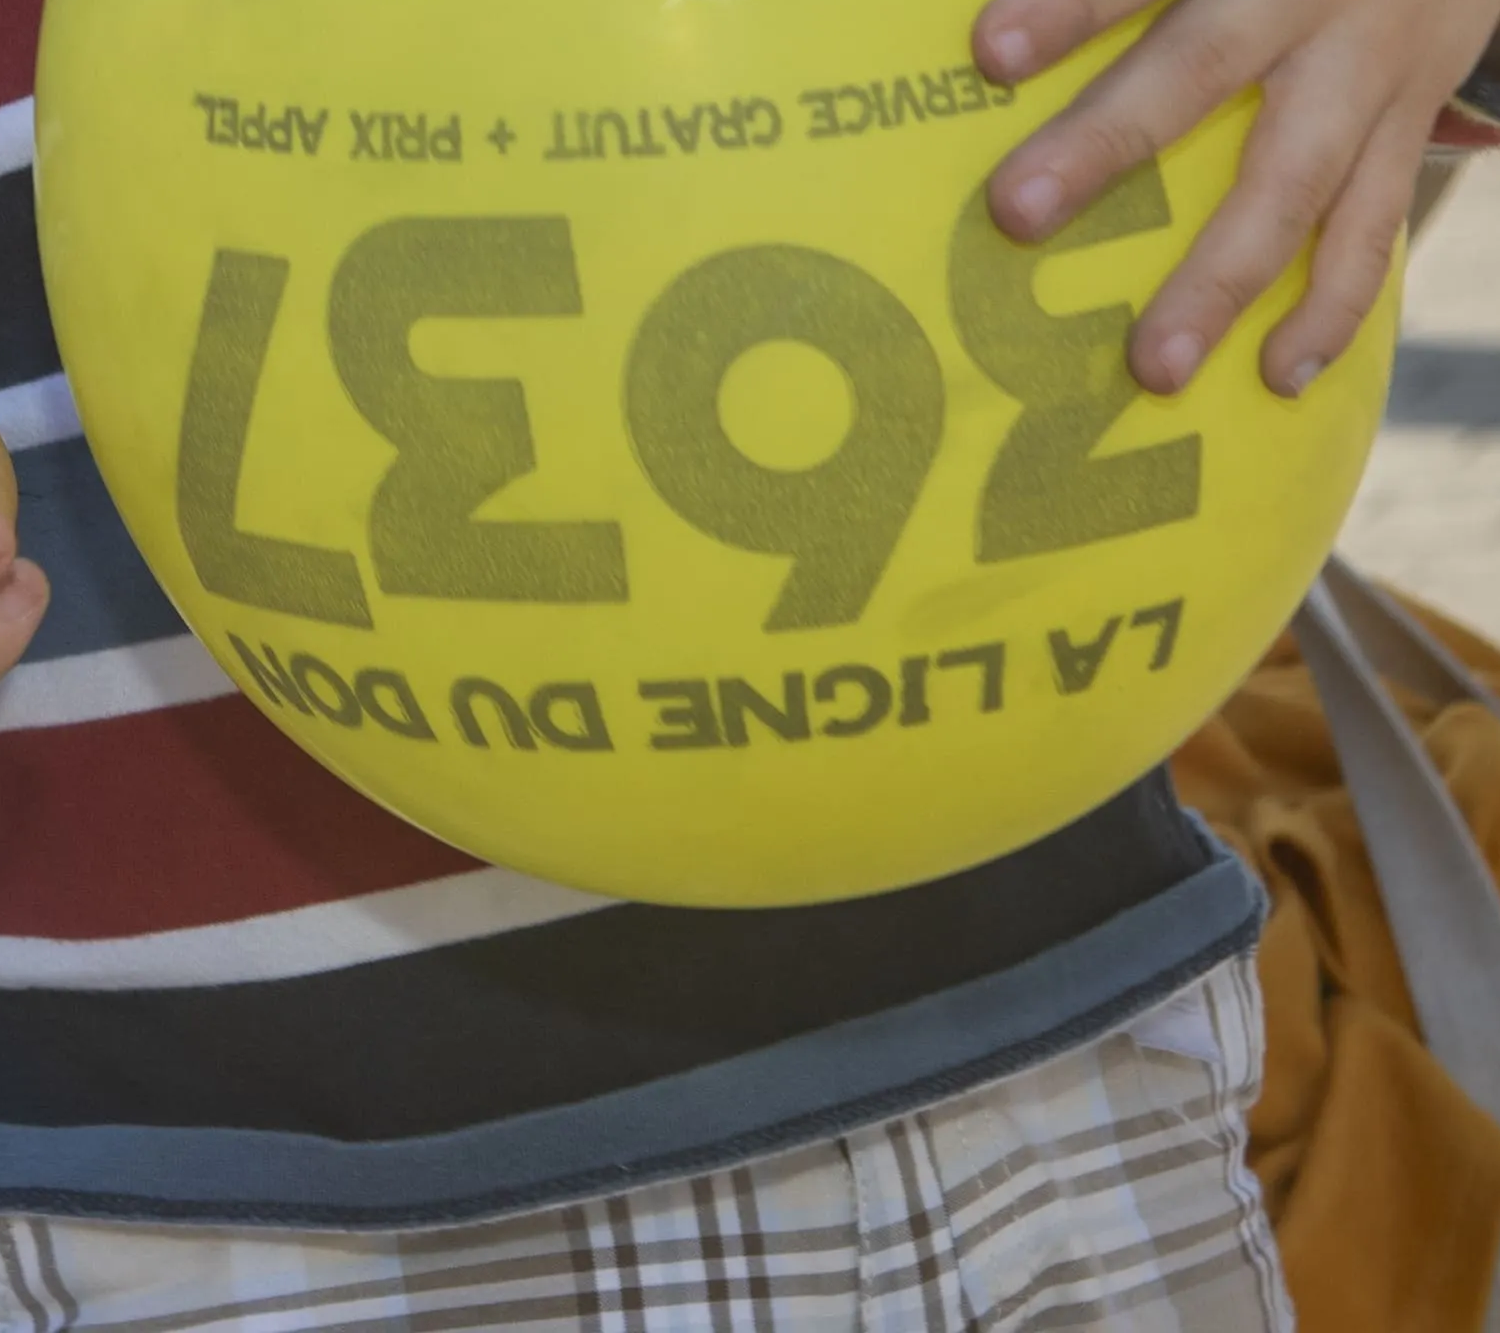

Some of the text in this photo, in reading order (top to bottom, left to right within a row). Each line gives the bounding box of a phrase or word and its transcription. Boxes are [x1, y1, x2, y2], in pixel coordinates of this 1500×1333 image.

[192, 91, 329, 155] APPEL
[350, 110, 463, 161] PRIX
[486, 117, 519, 155] +
[542, 97, 783, 161] GRATUIT
[175, 153, 1203, 632] 3637
[226, 597, 1186, 753] LA LIGNE DU DON
